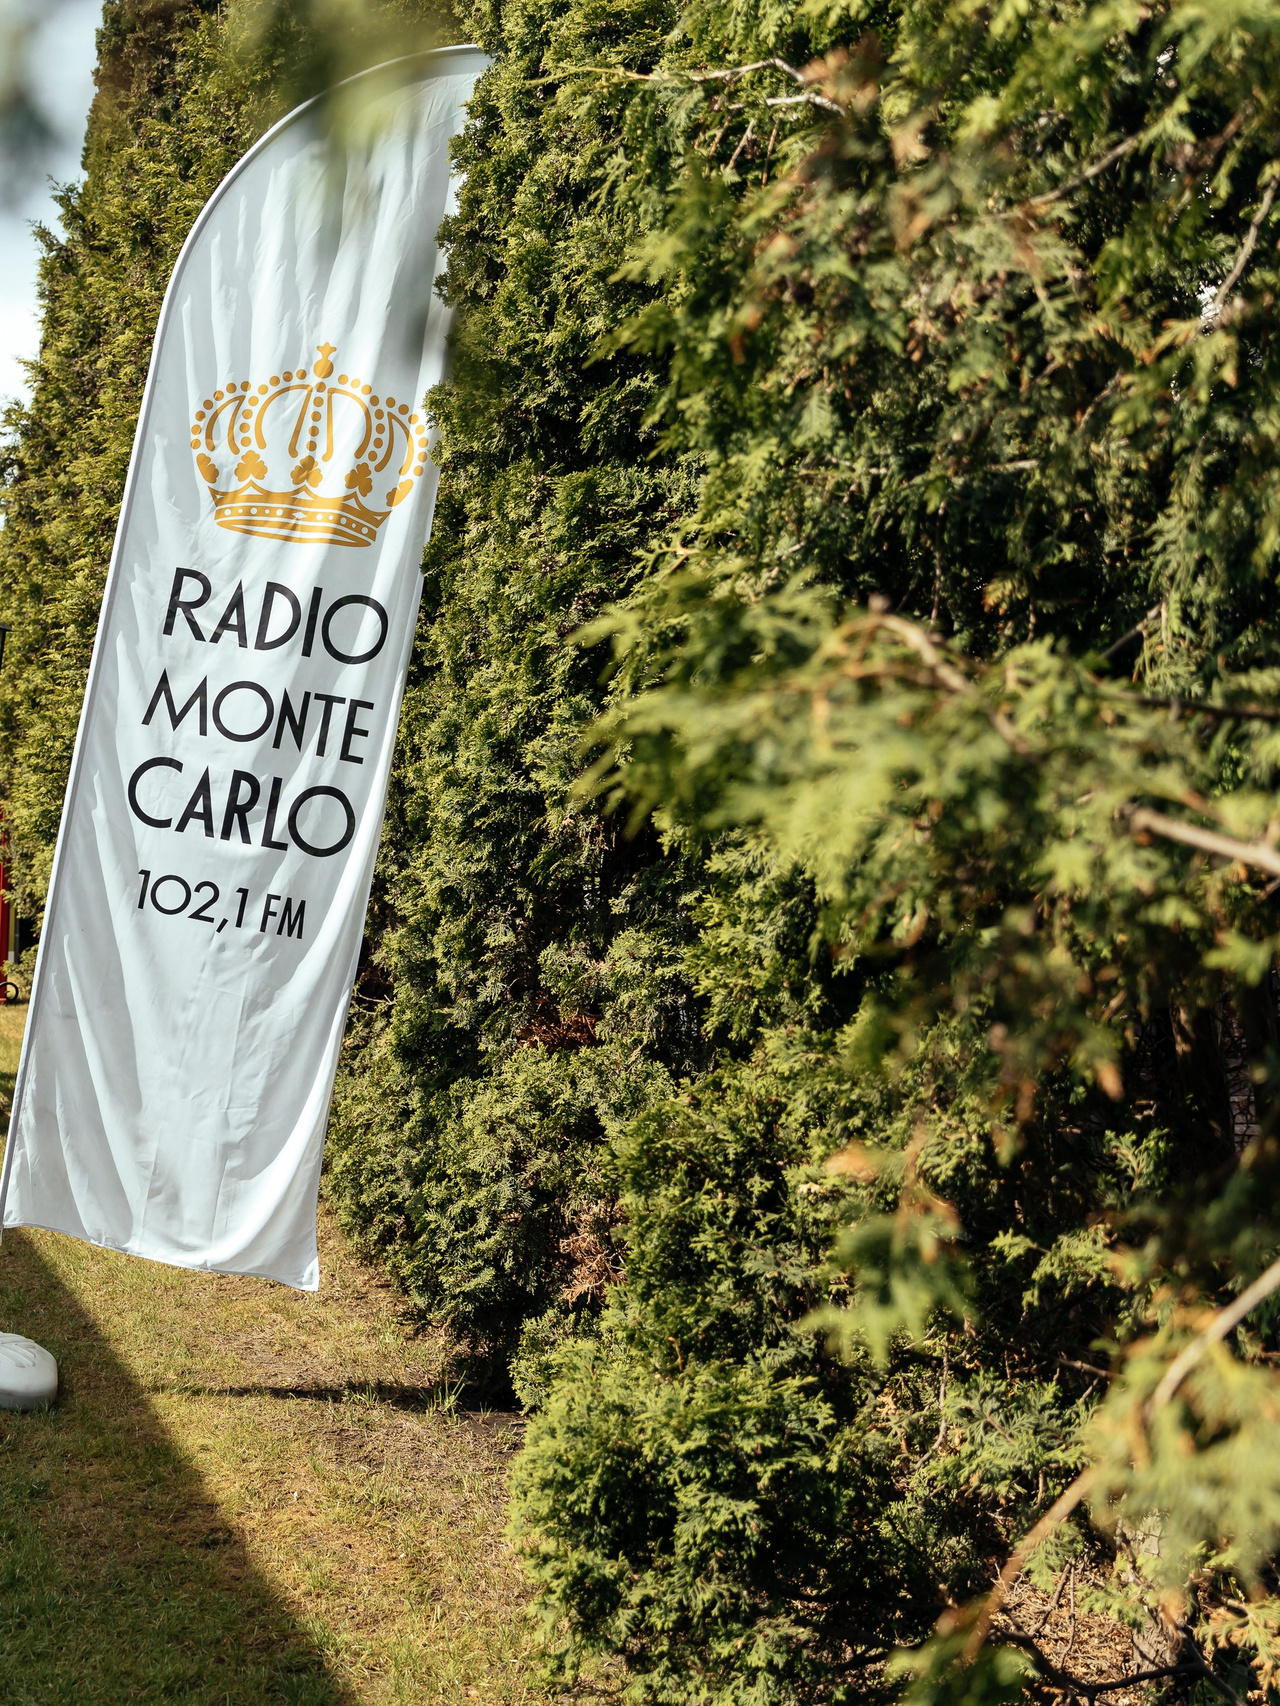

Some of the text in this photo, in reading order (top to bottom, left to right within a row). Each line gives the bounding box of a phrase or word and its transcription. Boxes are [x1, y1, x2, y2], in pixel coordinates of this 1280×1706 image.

[162, 567, 388, 665] RADIO
[141, 668, 374, 765] MONTE
[127, 756, 355, 857] CARLO
[137, 869, 307, 940] 102,1 FM
